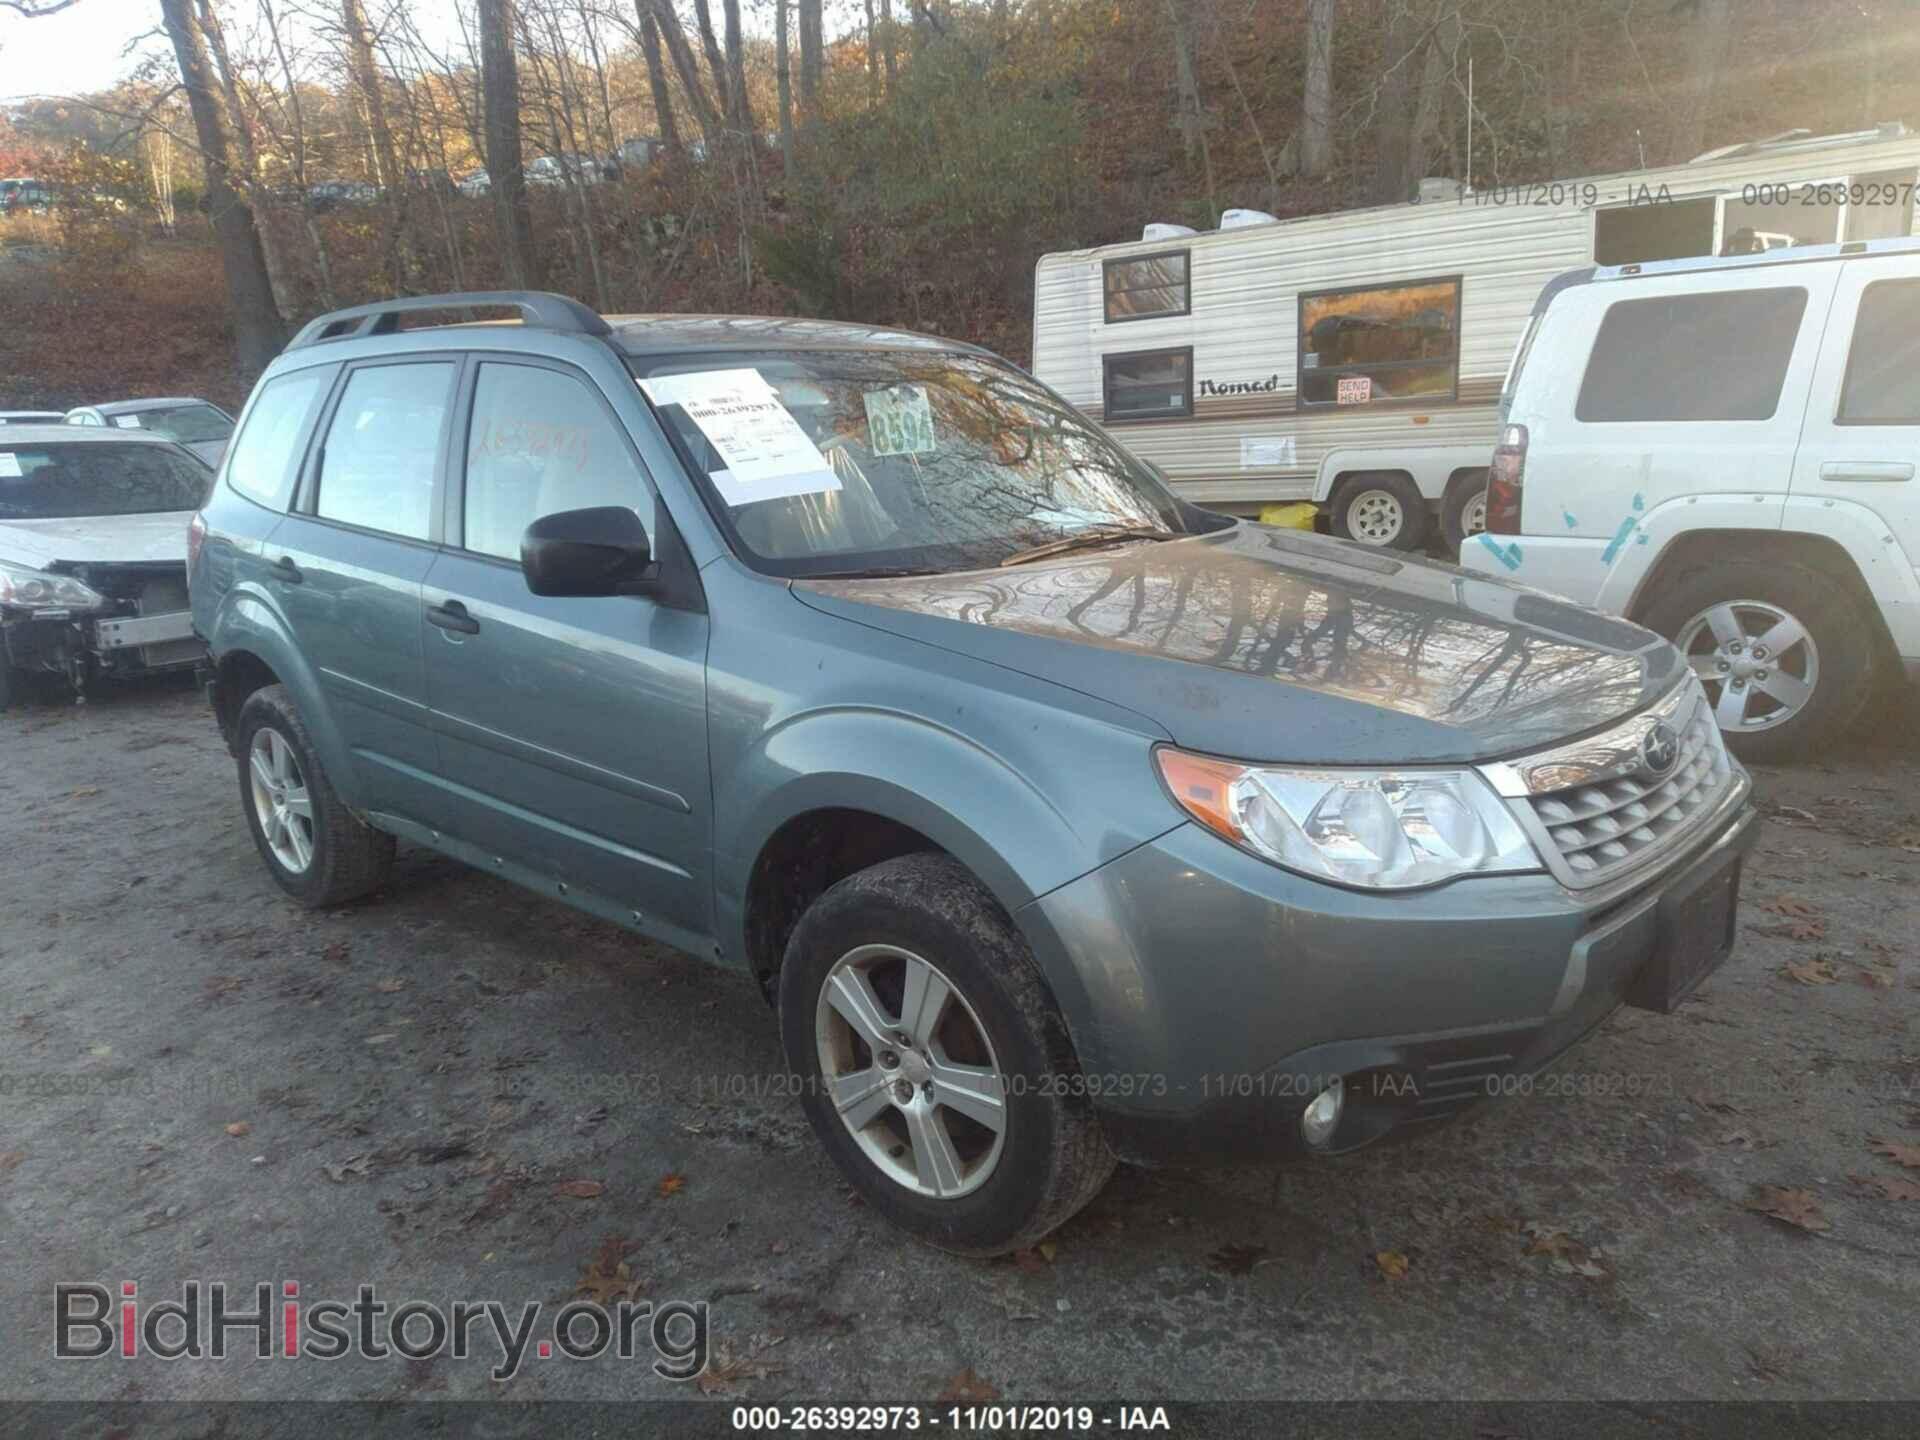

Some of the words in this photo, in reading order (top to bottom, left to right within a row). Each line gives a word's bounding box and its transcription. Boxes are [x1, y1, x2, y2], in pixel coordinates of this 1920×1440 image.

[1200, 374, 1278, 396] Nomad
[1339, 380, 1369, 391] SEND
[1339, 392, 1367, 403] HELP
